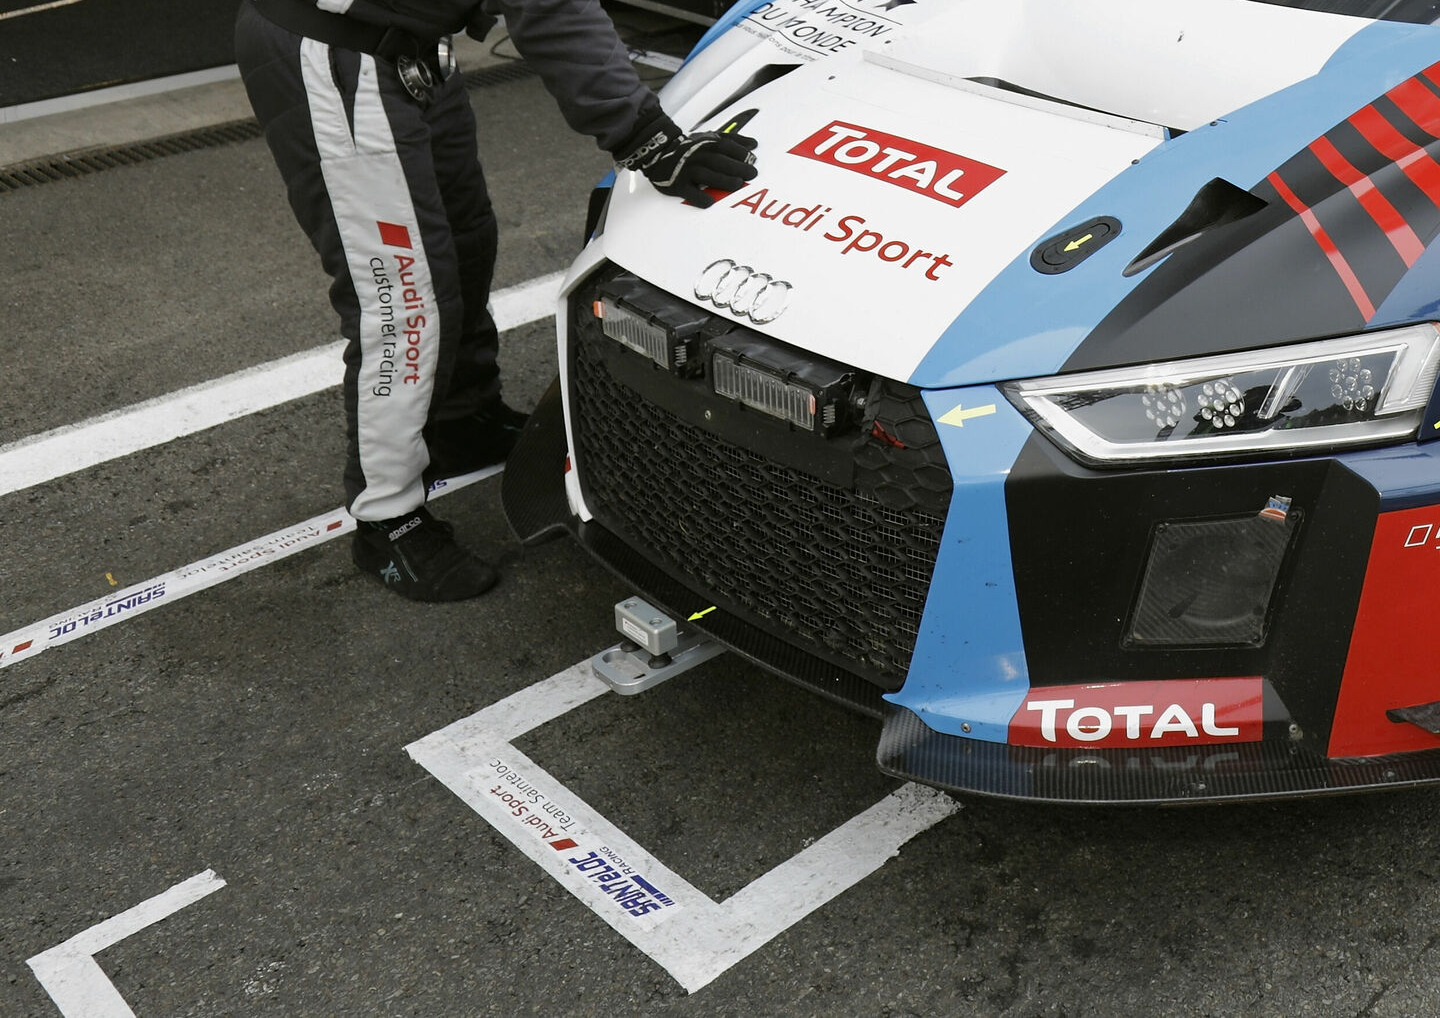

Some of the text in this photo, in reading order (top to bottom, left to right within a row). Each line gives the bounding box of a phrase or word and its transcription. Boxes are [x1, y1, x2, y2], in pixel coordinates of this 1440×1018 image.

[751, 2, 783, 21] DU
[780, 14, 856, 53] MONDE
[813, 124, 966, 201] TOTAL
[730, 188, 954, 281] Audi Sport
[370, 257, 398, 397] customer racing
[393, 254, 426, 385] Audi Sport
[218, 530, 320, 572] Audi Sport
[388, 516, 423, 542] sparco
[1027, 698, 1239, 742] TOTAL
[490, 785, 559, 840] Audi Sport
[542, 800, 576, 832] Team
[600, 845, 636, 875] RACING
